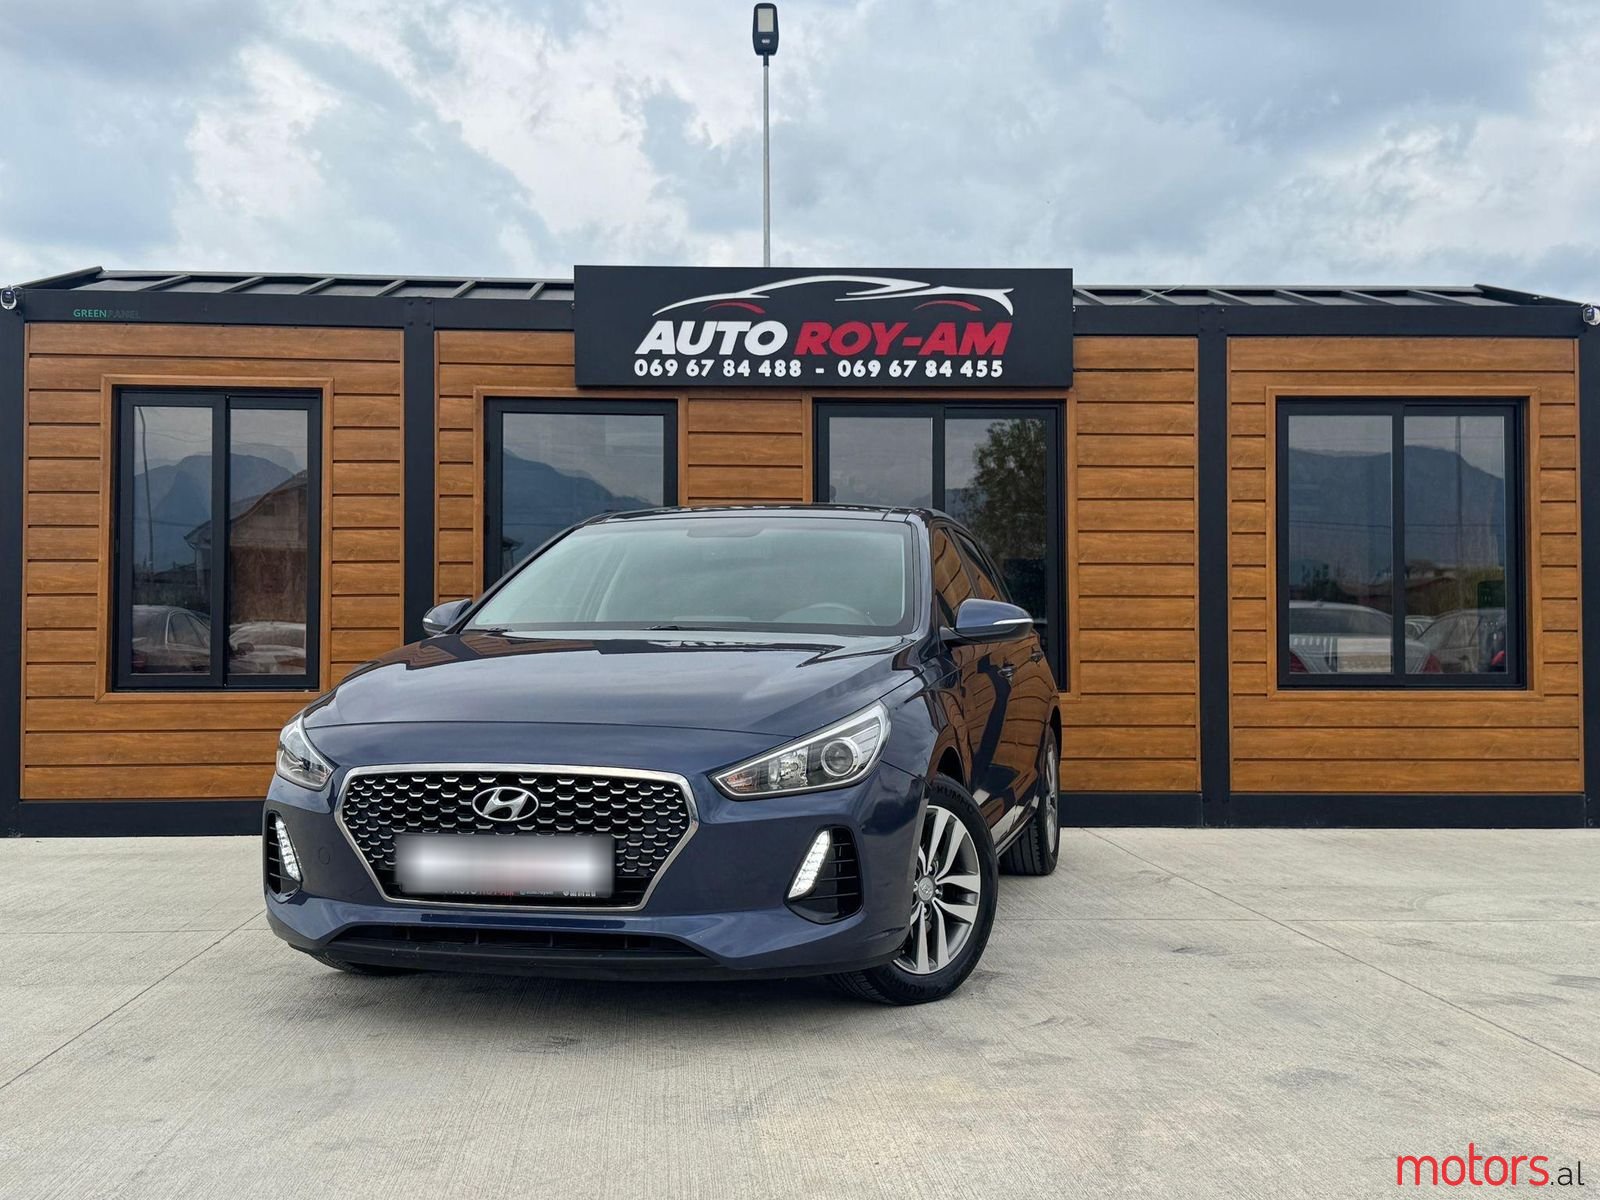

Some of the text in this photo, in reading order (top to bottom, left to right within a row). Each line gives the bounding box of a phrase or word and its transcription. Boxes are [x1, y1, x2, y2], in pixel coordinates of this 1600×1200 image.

[634, 320, 1012, 356] AUTO ROY-AM
[633, 358, 679, 377] 069
[685, 359, 715, 378] 67
[722, 359, 751, 377] 84
[758, 359, 802, 378] 488
[837, 359, 881, 378] 069
[888, 359, 918, 378] 67
[924, 359, 953, 378] 84
[959, 359, 1003, 378] 455
[936, 785, 975, 815] KUMHO
